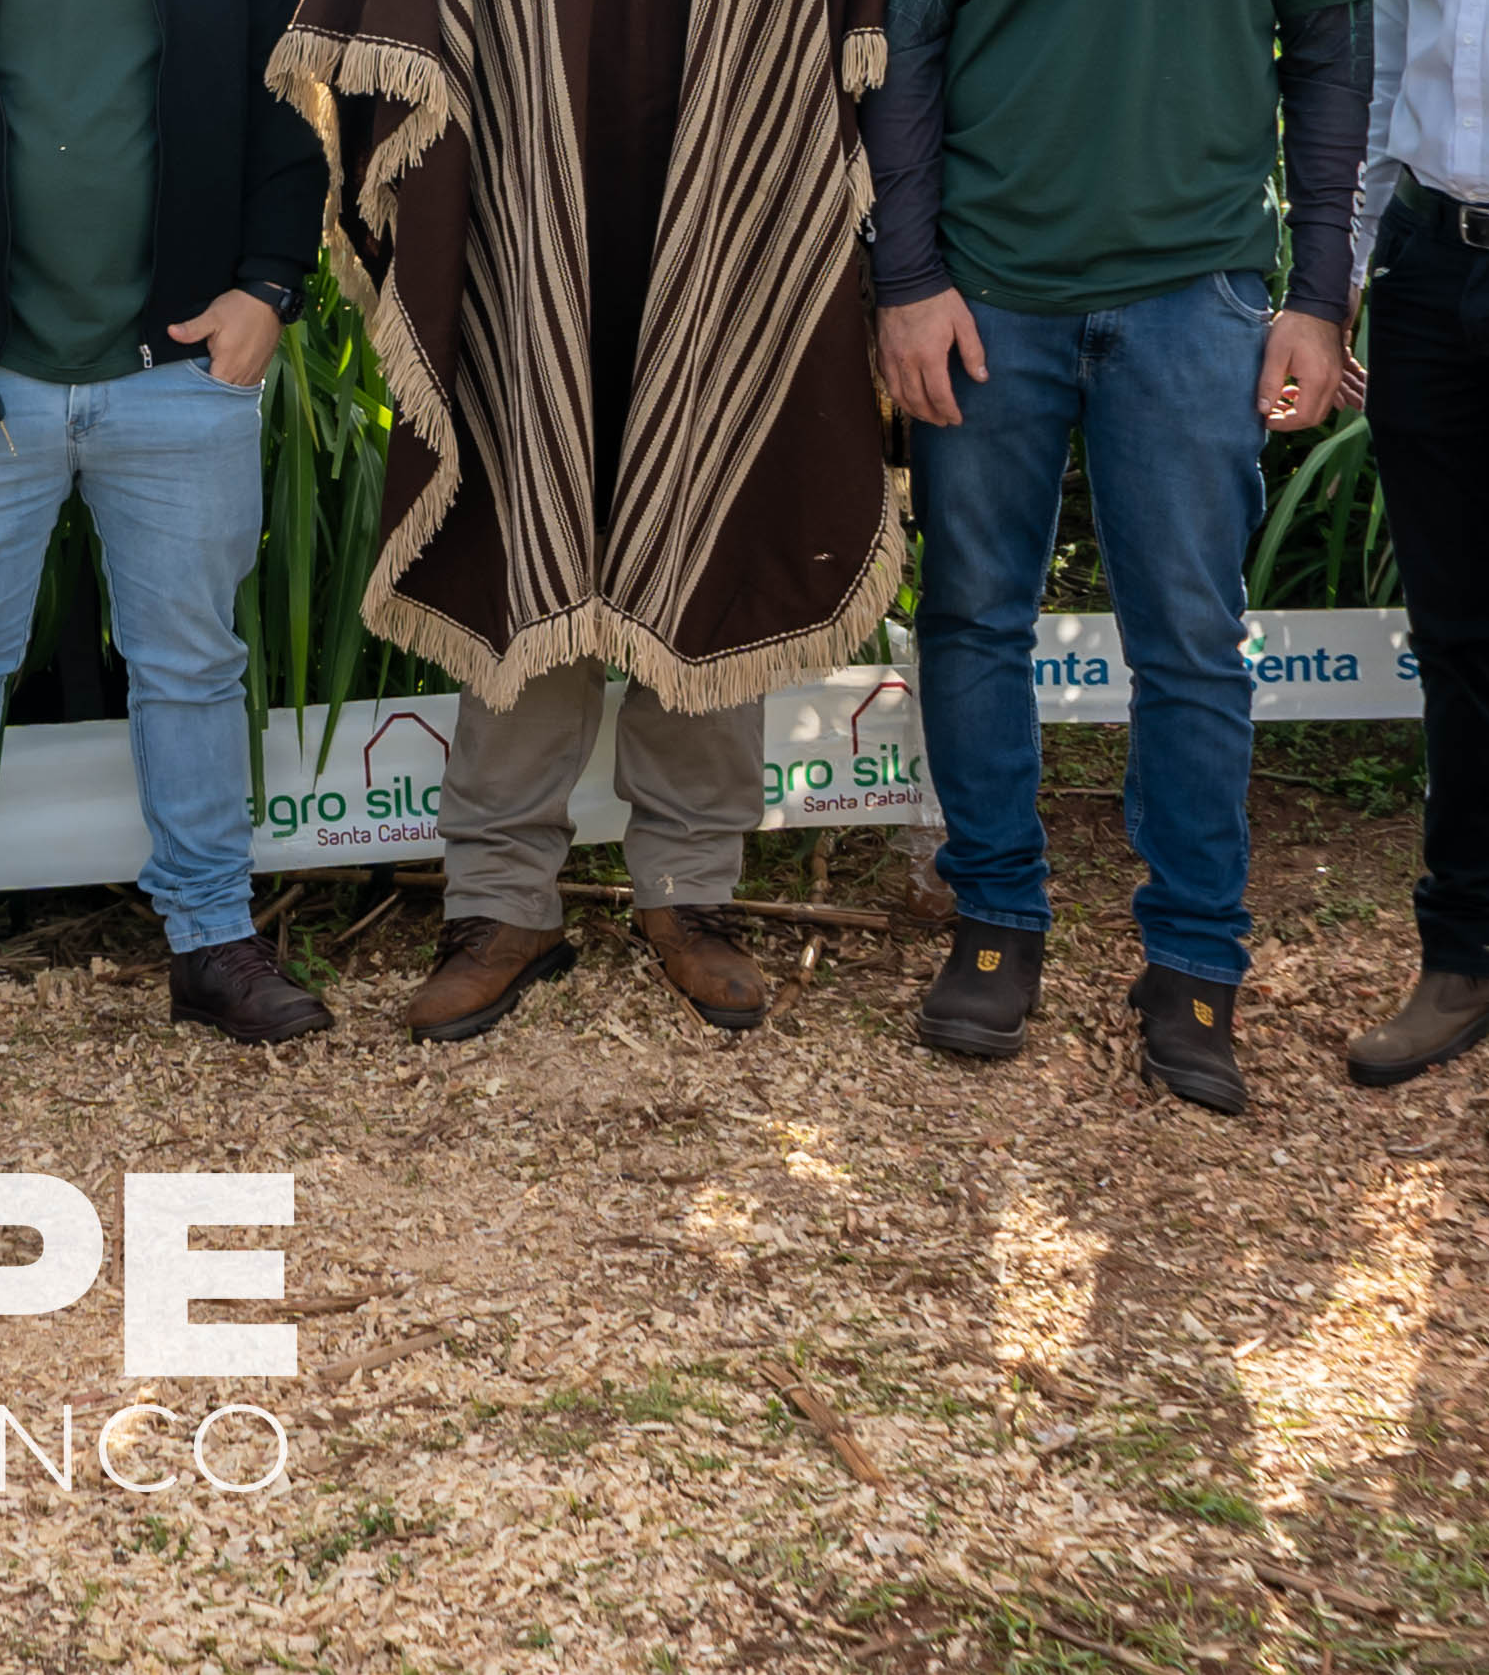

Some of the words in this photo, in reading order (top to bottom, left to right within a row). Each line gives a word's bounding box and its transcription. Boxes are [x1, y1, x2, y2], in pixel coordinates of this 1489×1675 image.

[764, 759, 833, 805] gro
[804, 794, 858, 812] Santa
[317, 827, 371, 846] Santa
